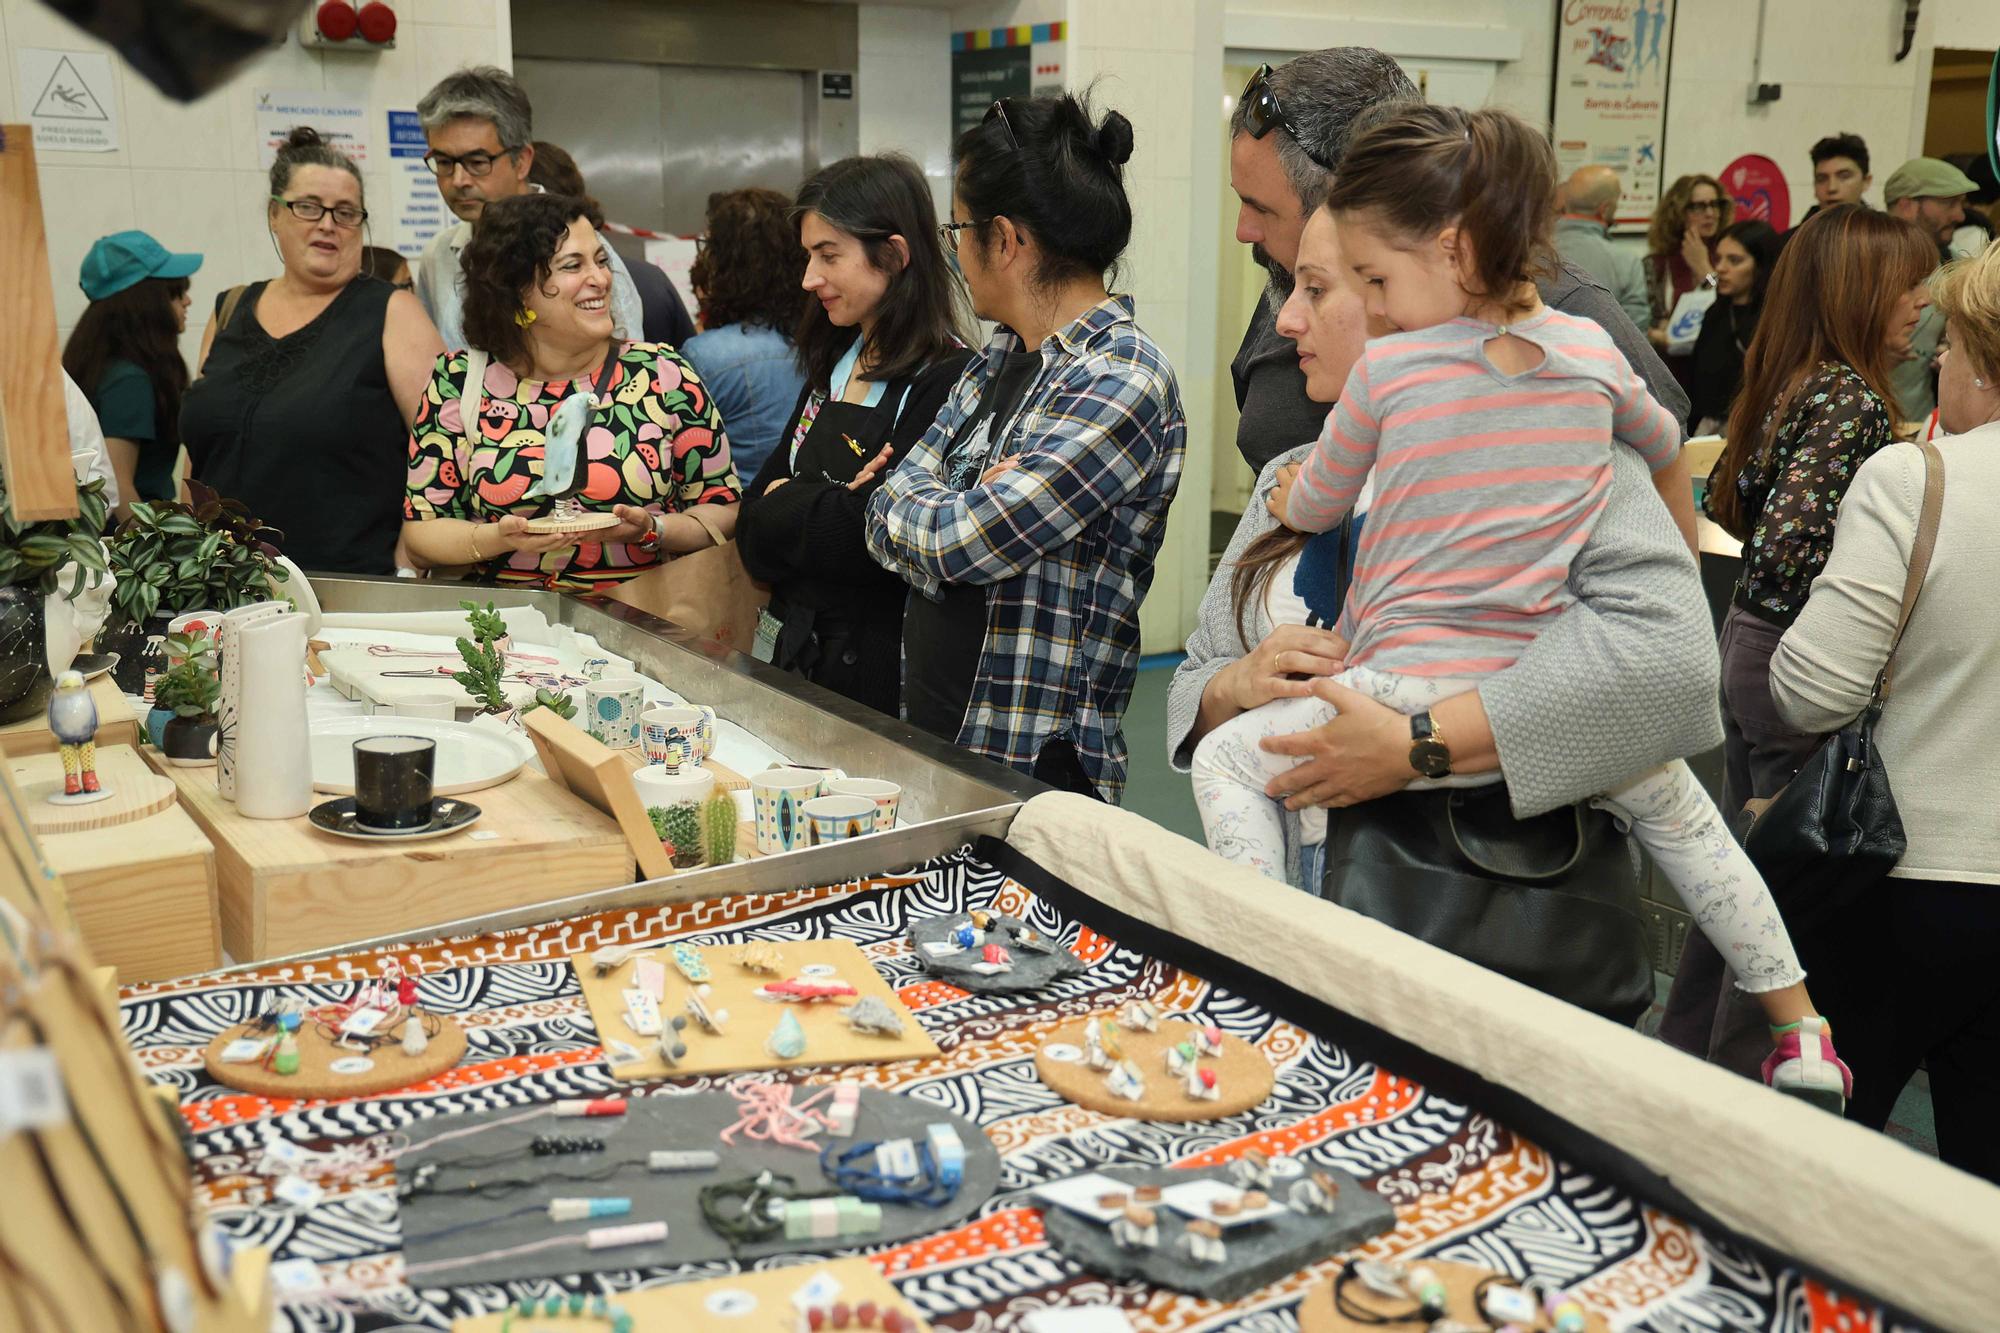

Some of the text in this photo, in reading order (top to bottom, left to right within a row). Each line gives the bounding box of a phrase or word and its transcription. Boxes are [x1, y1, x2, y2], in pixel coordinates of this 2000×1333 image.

[1584, 97, 1610, 110] Barrio
[276, 105, 320, 115] MERCADO
[322, 107, 363, 117] CALVARIO
[36, 134, 109, 146] SUELO MOJADO
